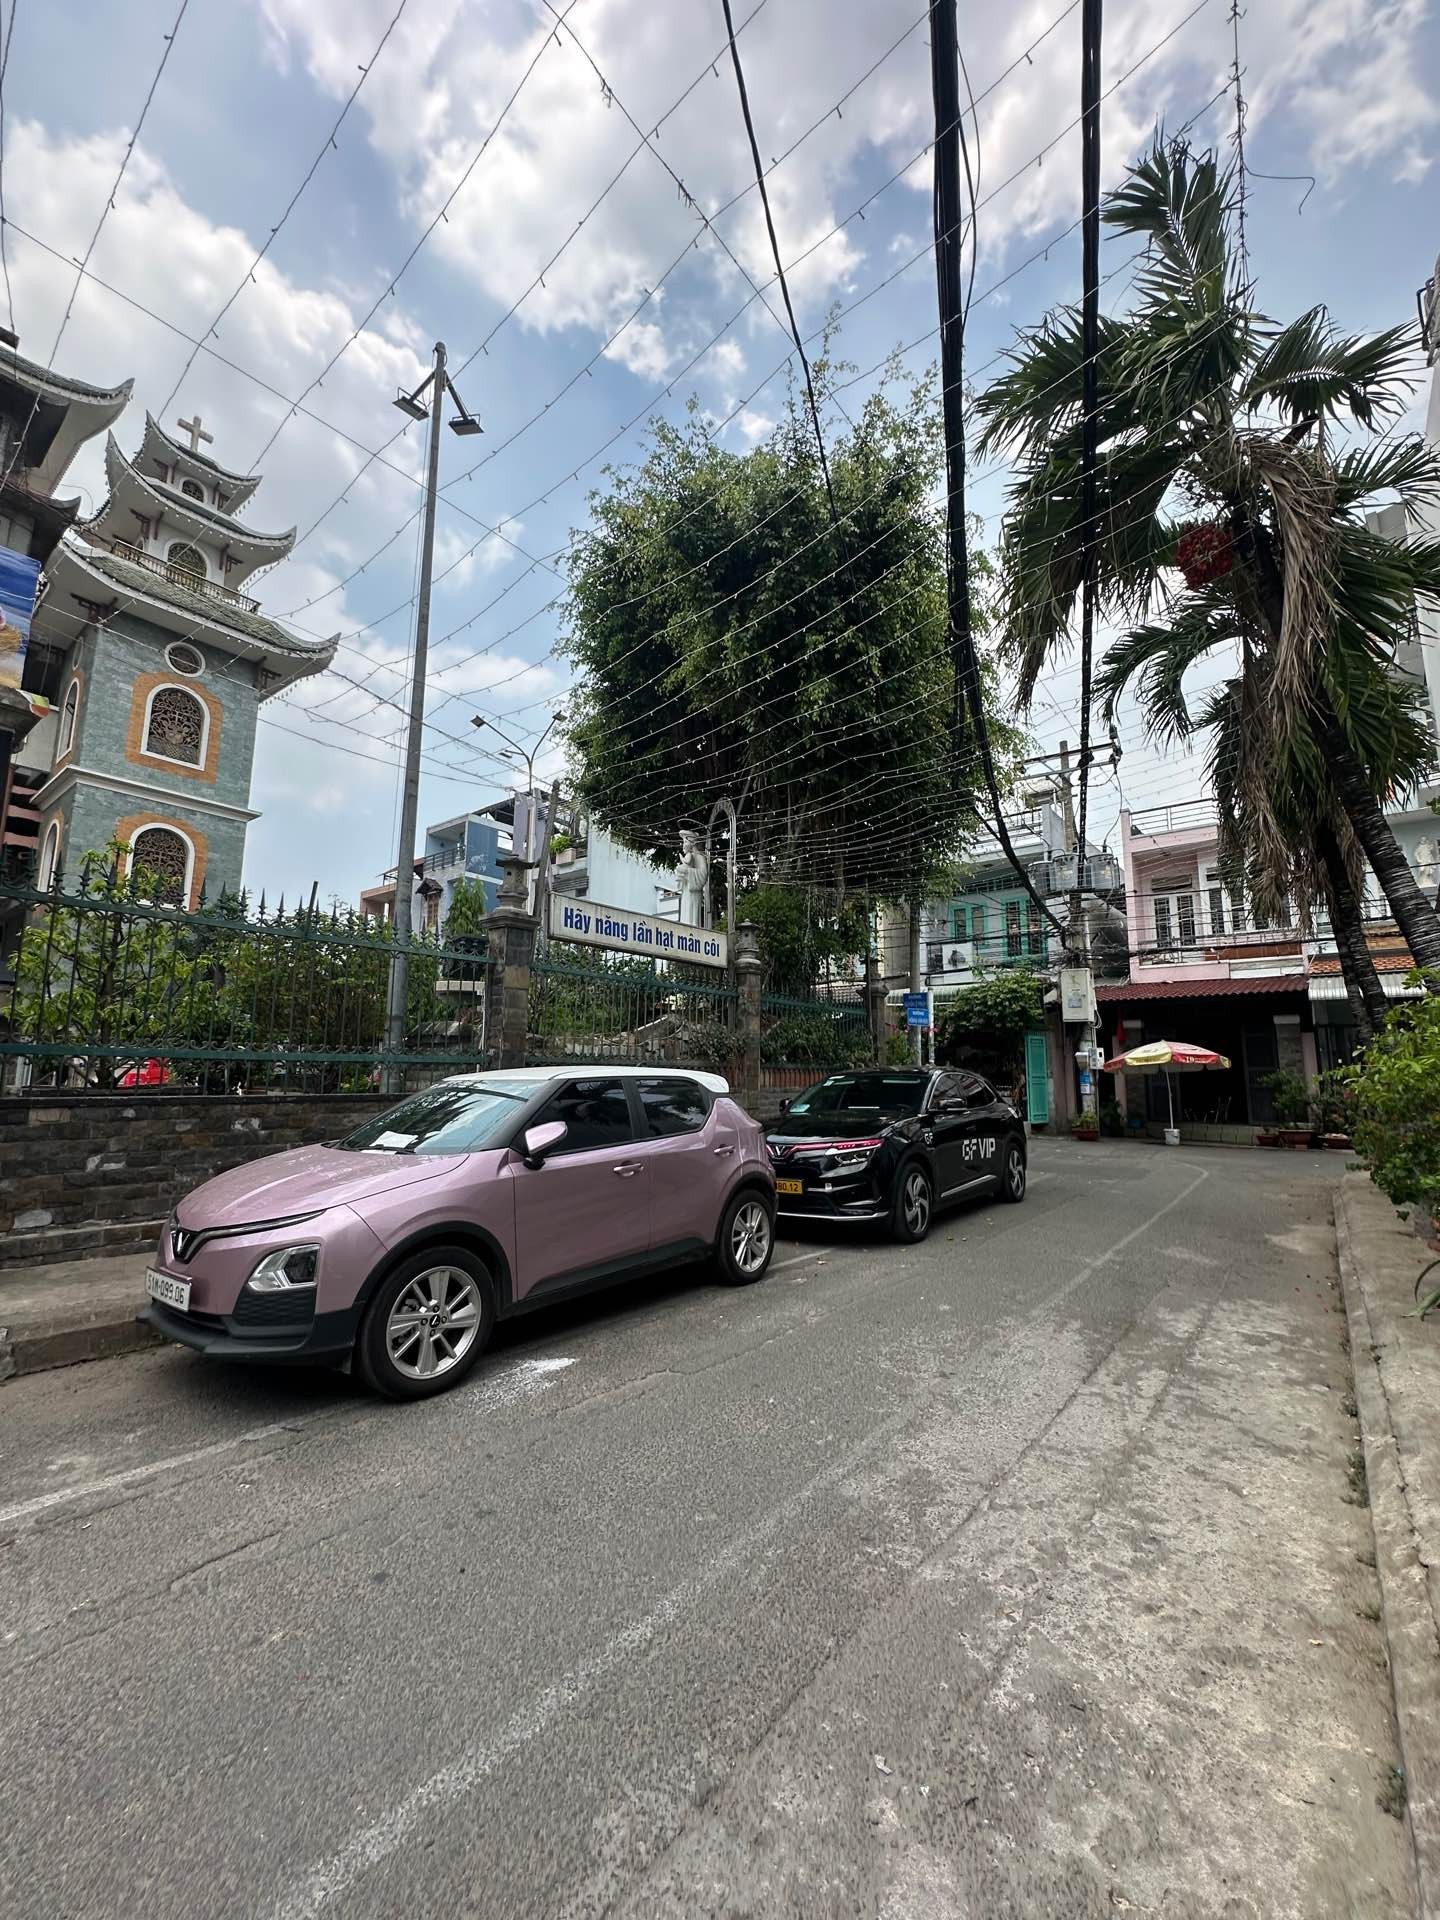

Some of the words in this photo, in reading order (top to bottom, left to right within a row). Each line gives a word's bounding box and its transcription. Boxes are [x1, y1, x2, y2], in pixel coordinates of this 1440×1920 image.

[563, 906, 592, 934] Hãy
[595, 914, 629, 942] năng
[632, 921, 653, 945] lần
[655, 927, 675, 951] hạt
[677, 933, 701, 954] mân
[704, 938, 720, 957] côi
[978, 1137, 996, 1159] VIP
